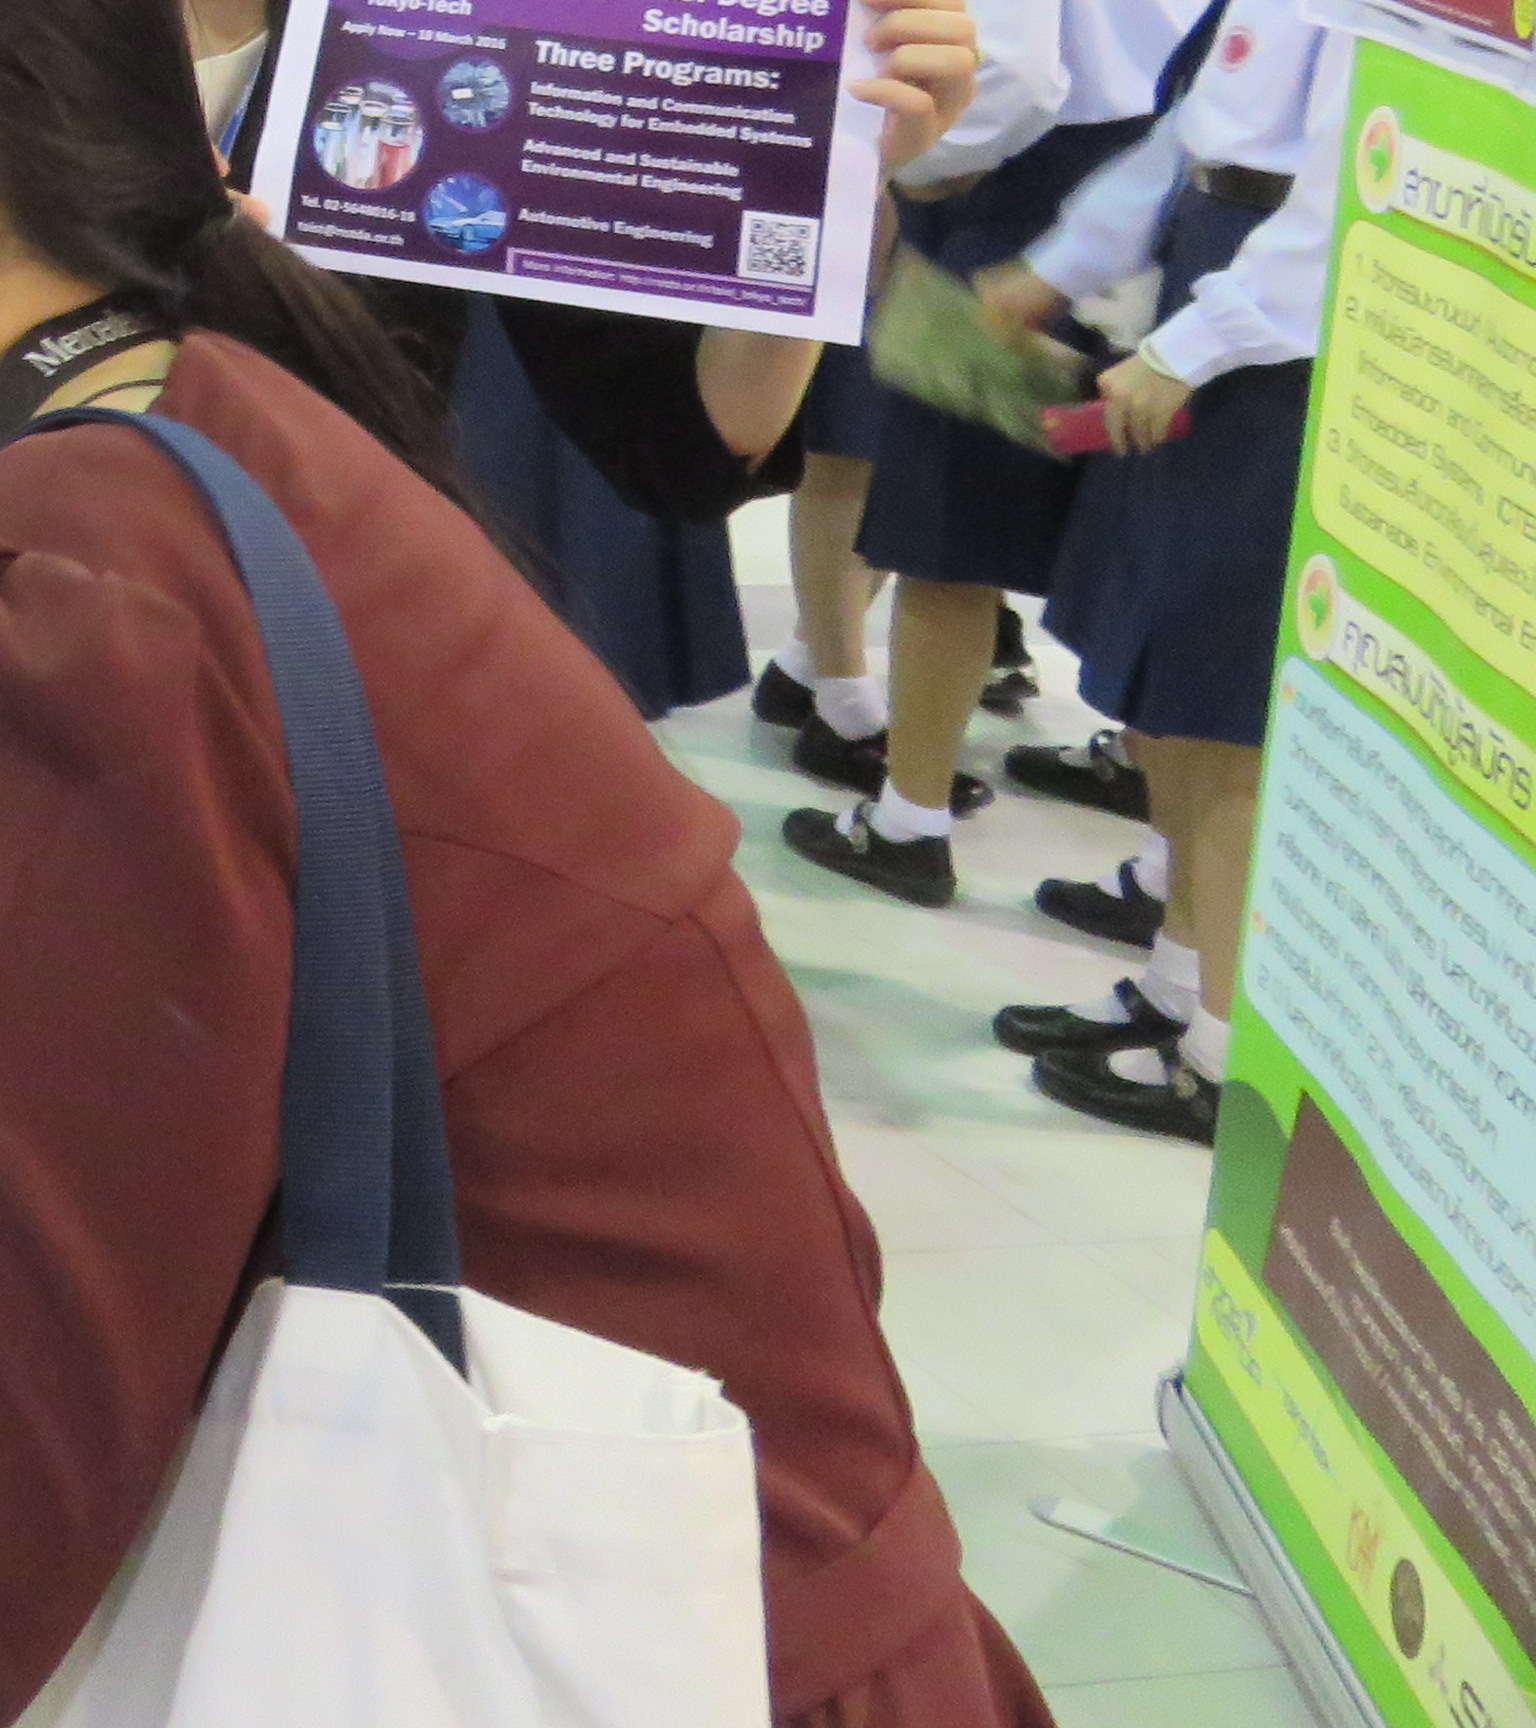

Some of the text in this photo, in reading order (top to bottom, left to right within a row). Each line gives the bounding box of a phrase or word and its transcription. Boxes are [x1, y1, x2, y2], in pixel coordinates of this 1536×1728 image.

[642, 9, 825, 53] Scholarship
[535, 40, 781, 90] Three Programs:
[530, 81, 796, 124] Information and Communication
[526, 101, 813, 149] Technology for Embedded Systems
[523, 138, 740, 177] Advanced and Sustainable
[300, 194, 322, 209] Tel.
[521, 158, 744, 202] Environmental Engineering
[518, 208, 715, 250] Automotive Engineering
